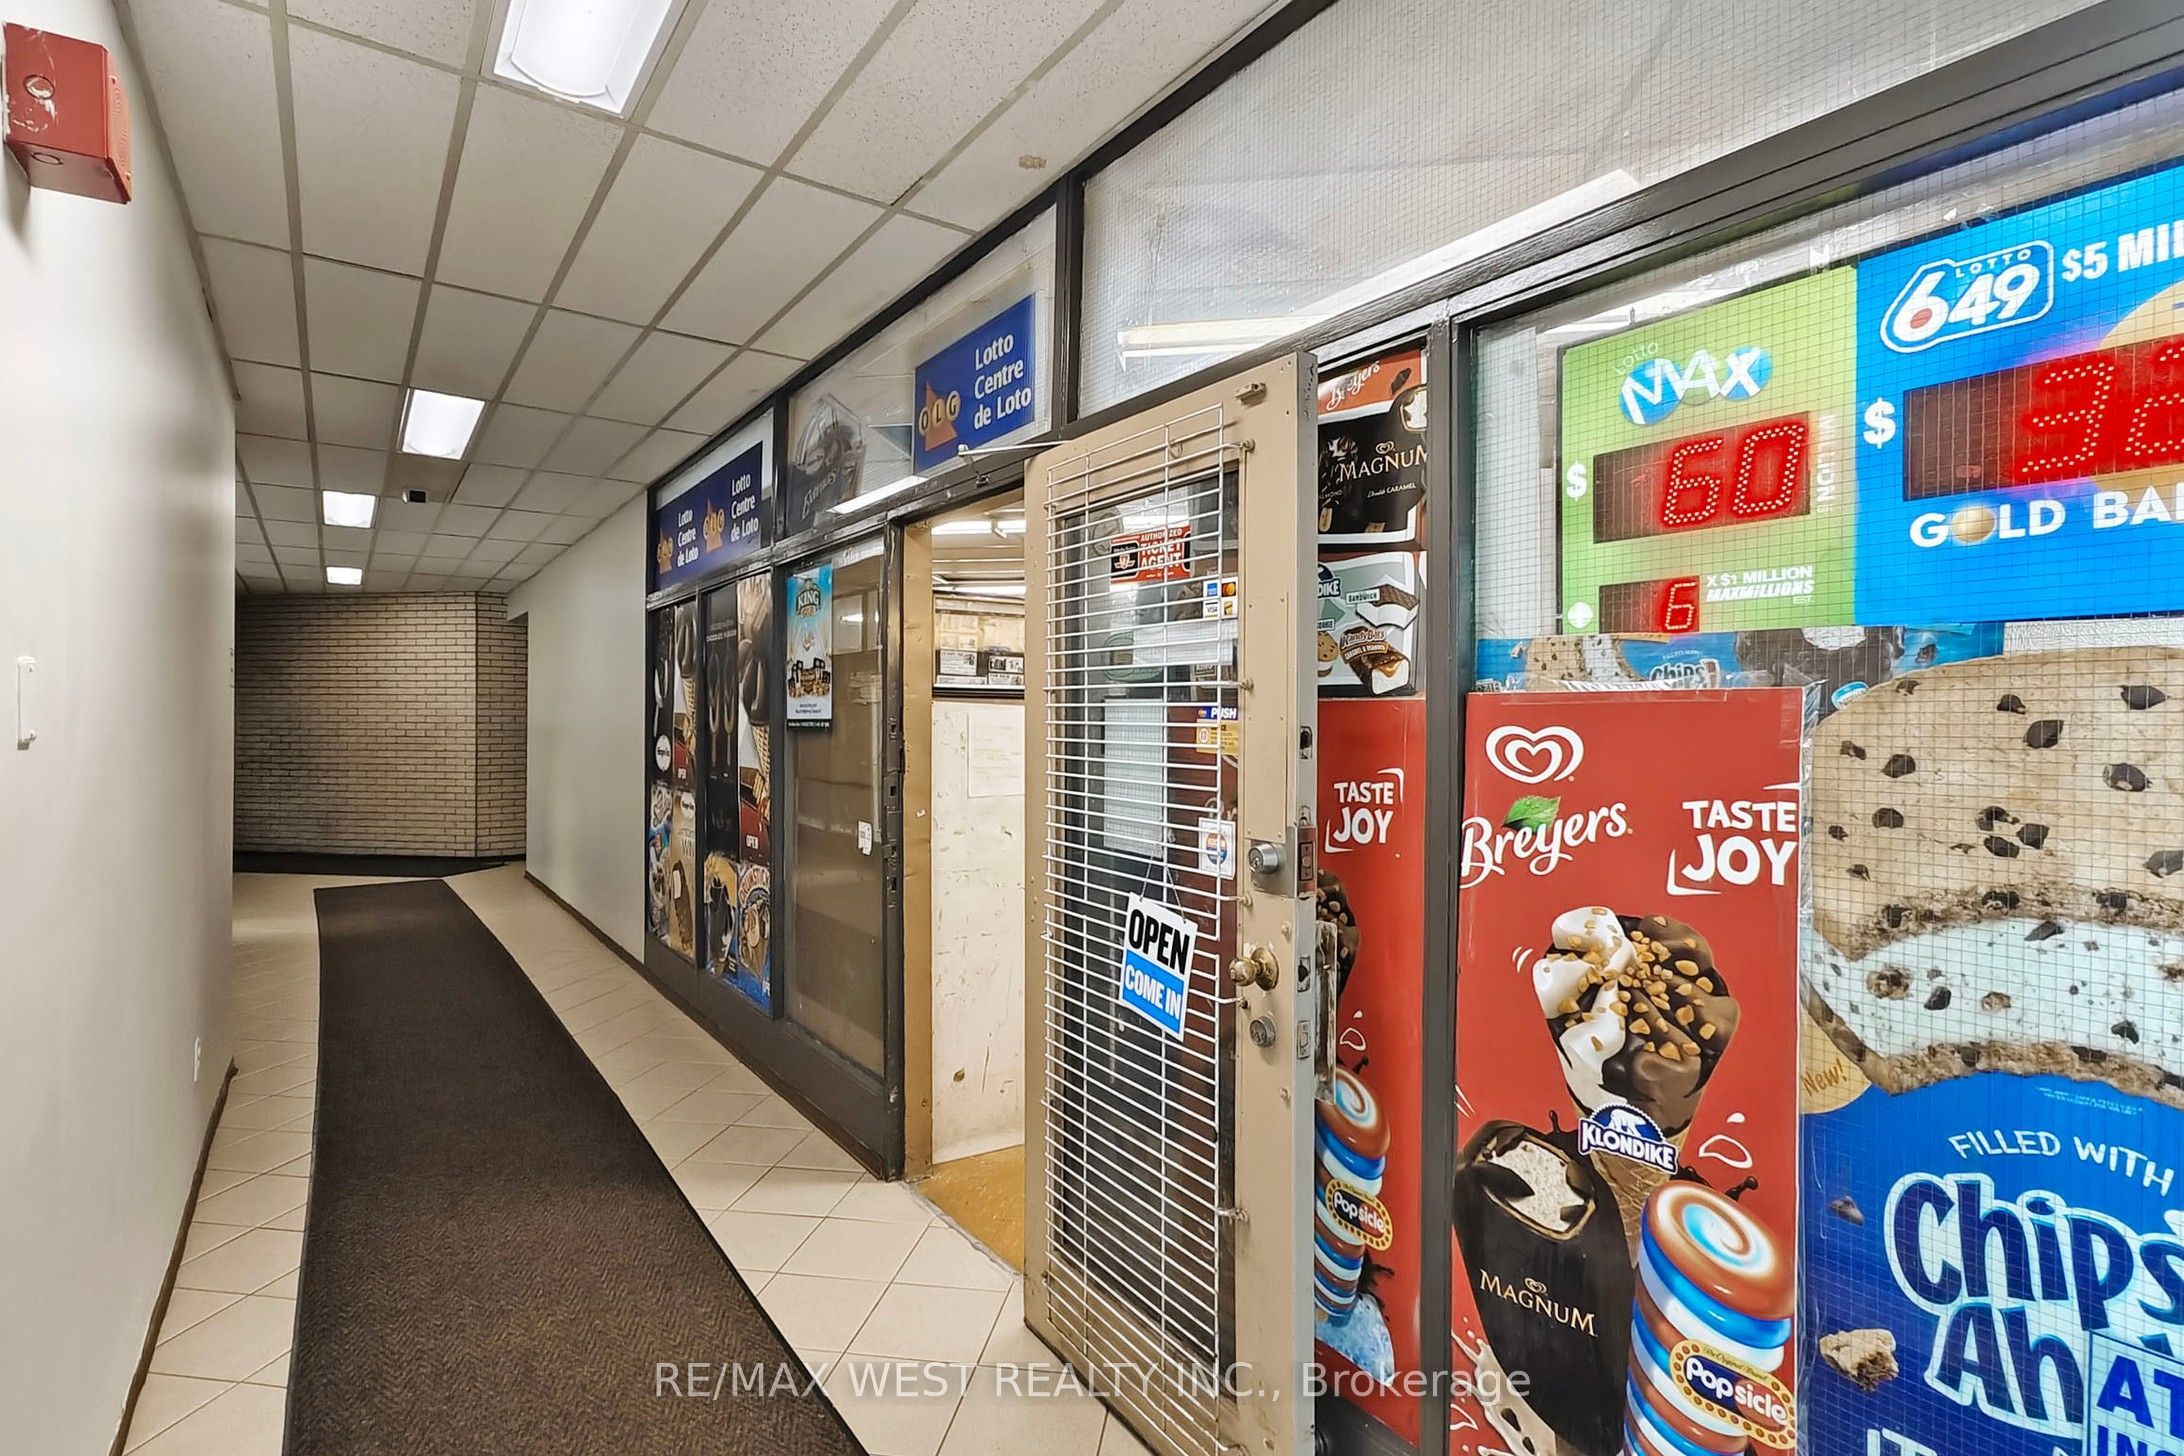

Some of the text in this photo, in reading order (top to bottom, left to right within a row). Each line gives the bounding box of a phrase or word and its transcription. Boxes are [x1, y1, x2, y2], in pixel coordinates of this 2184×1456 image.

[1955, 248, 2032, 279] LOTTO
[2061, 240, 2109, 283] $5
[1892, 262, 2041, 343] 649
[975, 334, 1014, 371] Lotto
[974, 359, 1024, 400] Centre
[1325, 360, 1382, 411] Breyers
[1621, 346, 1763, 426] MAX
[919, 391, 960, 434] OLG
[973, 387, 1032, 430] de Loto
[1862, 397, 1897, 450] $
[731, 473, 751, 497] Lotto
[1386, 482, 1417, 493] CARAMEL
[1566, 423, 1805, 526] $ 60
[731, 495, 756, 520] Centre
[677, 527, 697, 548] Centre
[730, 517, 759, 543] de Loto
[1140, 528, 1183, 542] AUTHORZED
[1705, 579, 1815, 602] MAXMILLIONS
[1706, 565, 1814, 588] X $1 MILLION
[1662, 579, 1698, 633] 6
[1333, 781, 1395, 805] TASTE
[1333, 806, 1394, 845] JOY
[1681, 799, 1798, 833] TASTE
[1459, 802, 1630, 889] Breyers
[1681, 834, 1798, 887] JOY
[1128, 908, 1191, 976] OPEN
[1124, 962, 1182, 1021] COME IN
[1800, 1058, 1849, 1098] New!
[1581, 1121, 1677, 1173] KLONDIKE
[1948, 1129, 2176, 1197] FILLED WITH
[1333, 1190, 1386, 1234] Popsicle
[1890, 1175, 2184, 1332] Chips
[1479, 1268, 1598, 1338] MAGNUM
[1683, 1356, 1789, 1427] Popsicle
